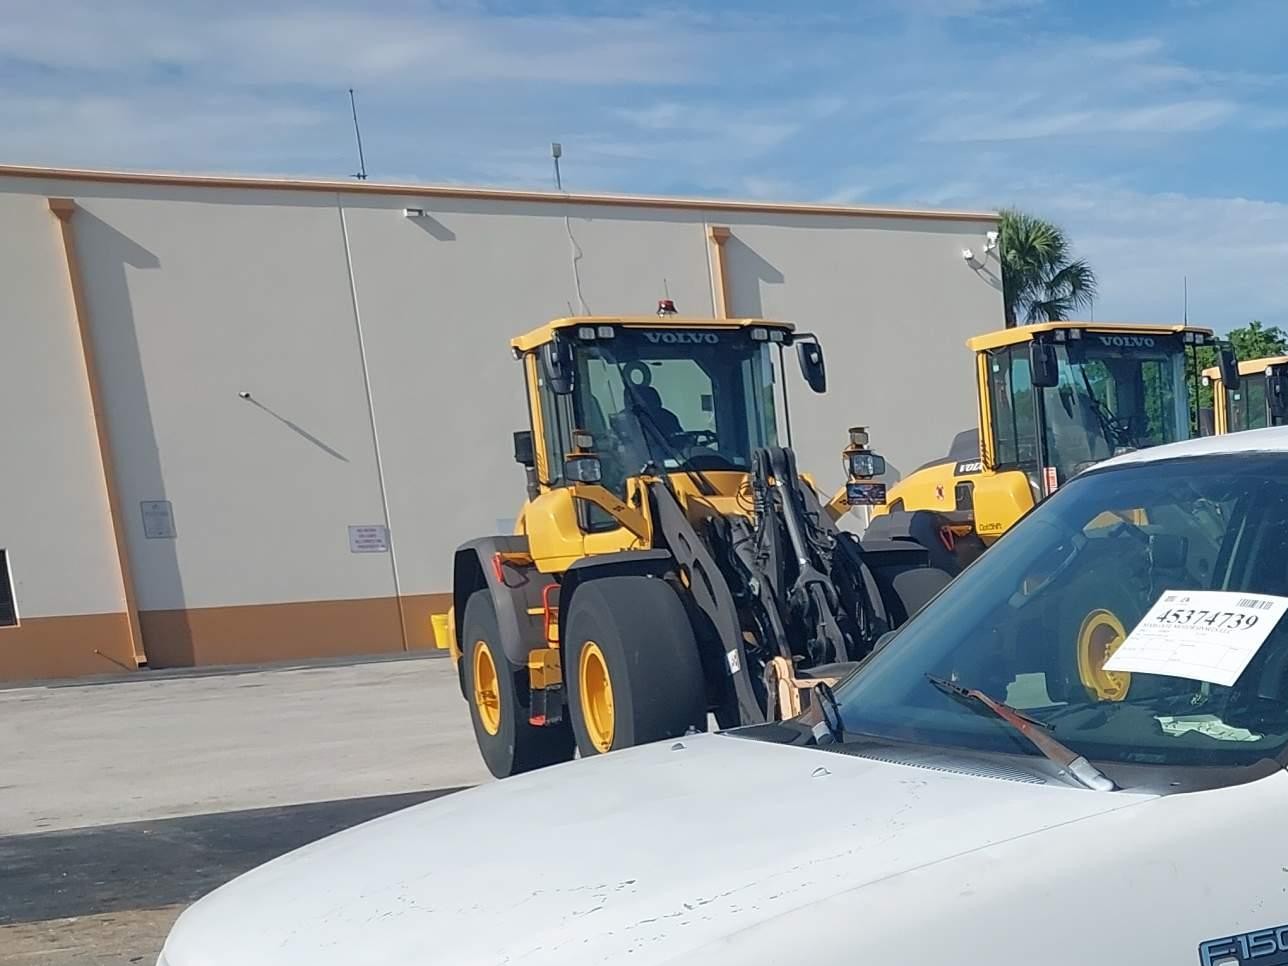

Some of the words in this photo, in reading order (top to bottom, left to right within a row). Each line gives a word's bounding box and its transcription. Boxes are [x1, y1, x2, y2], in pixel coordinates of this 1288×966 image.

[642, 332, 720, 344] VOLVO
[1098, 336, 1155, 348] VOLVO
[959, 462, 983, 473] VOL
[1156, 608, 1259, 631] 45374739
